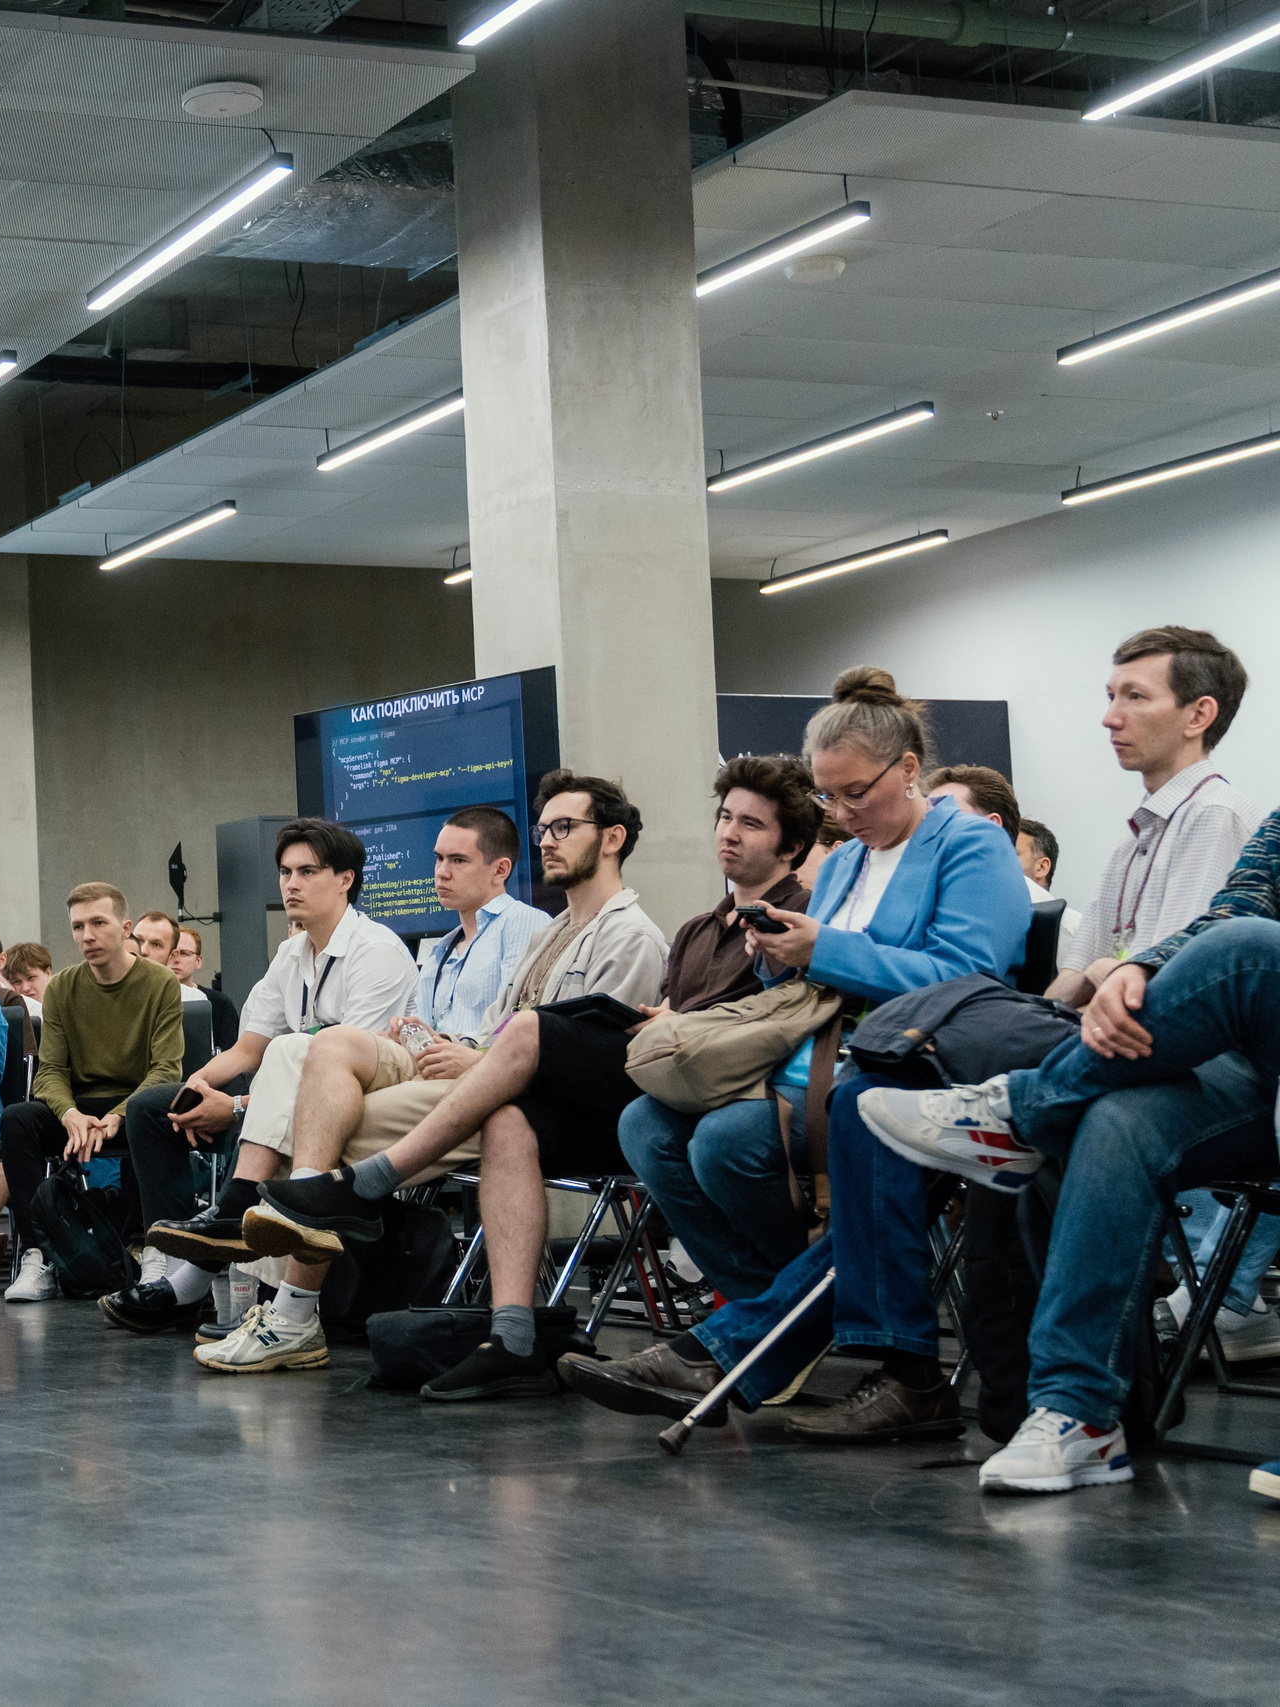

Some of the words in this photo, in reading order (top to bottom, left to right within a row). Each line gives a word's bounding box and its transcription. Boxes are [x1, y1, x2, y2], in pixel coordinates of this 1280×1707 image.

[351, 704, 375, 723] КАК
[376, 689, 460, 719] ПОДКЛЮЧИТЬ
[380, 730, 396, 739] Figma
[344, 761, 372, 772] "Framelink
[374, 759, 389, 769] Figma
[390, 756, 405, 765] MCP":
[350, 781, 370, 790] "args":
[385, 824, 398, 832] JIRA
[429, 904, 442, 914] jira
